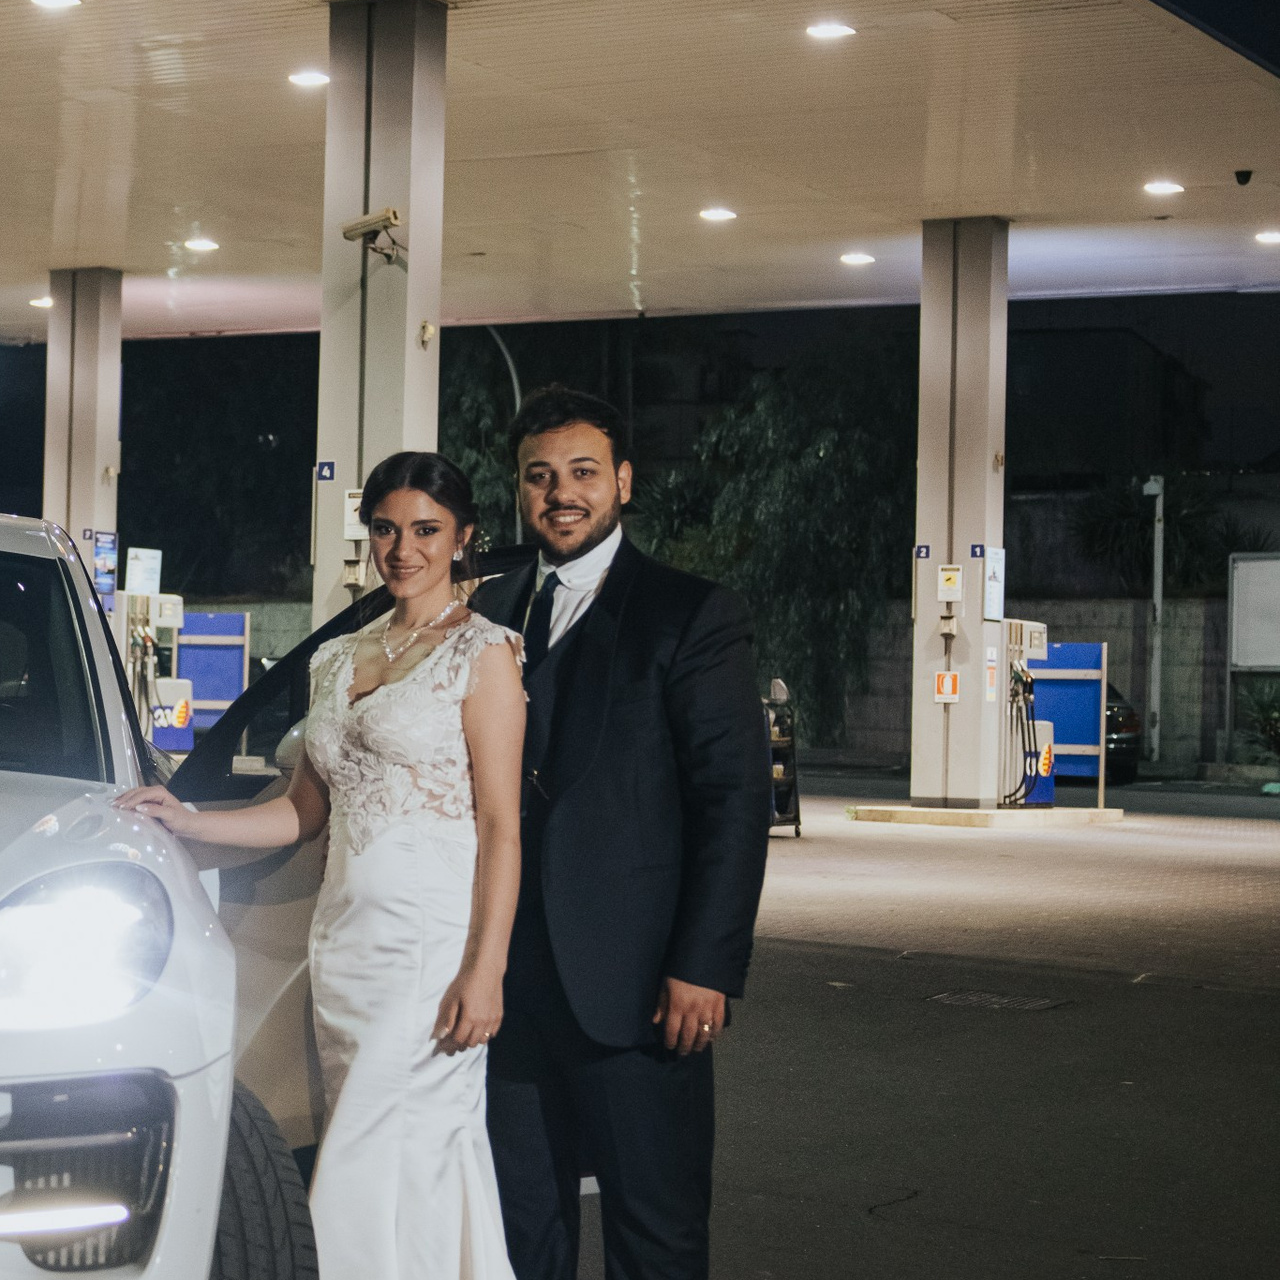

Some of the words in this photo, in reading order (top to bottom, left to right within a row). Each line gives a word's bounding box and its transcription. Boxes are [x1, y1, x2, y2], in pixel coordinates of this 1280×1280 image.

[322, 466, 330, 478] 4
[920, 547, 927, 557] 2
[975, 547, 981, 557] 1
